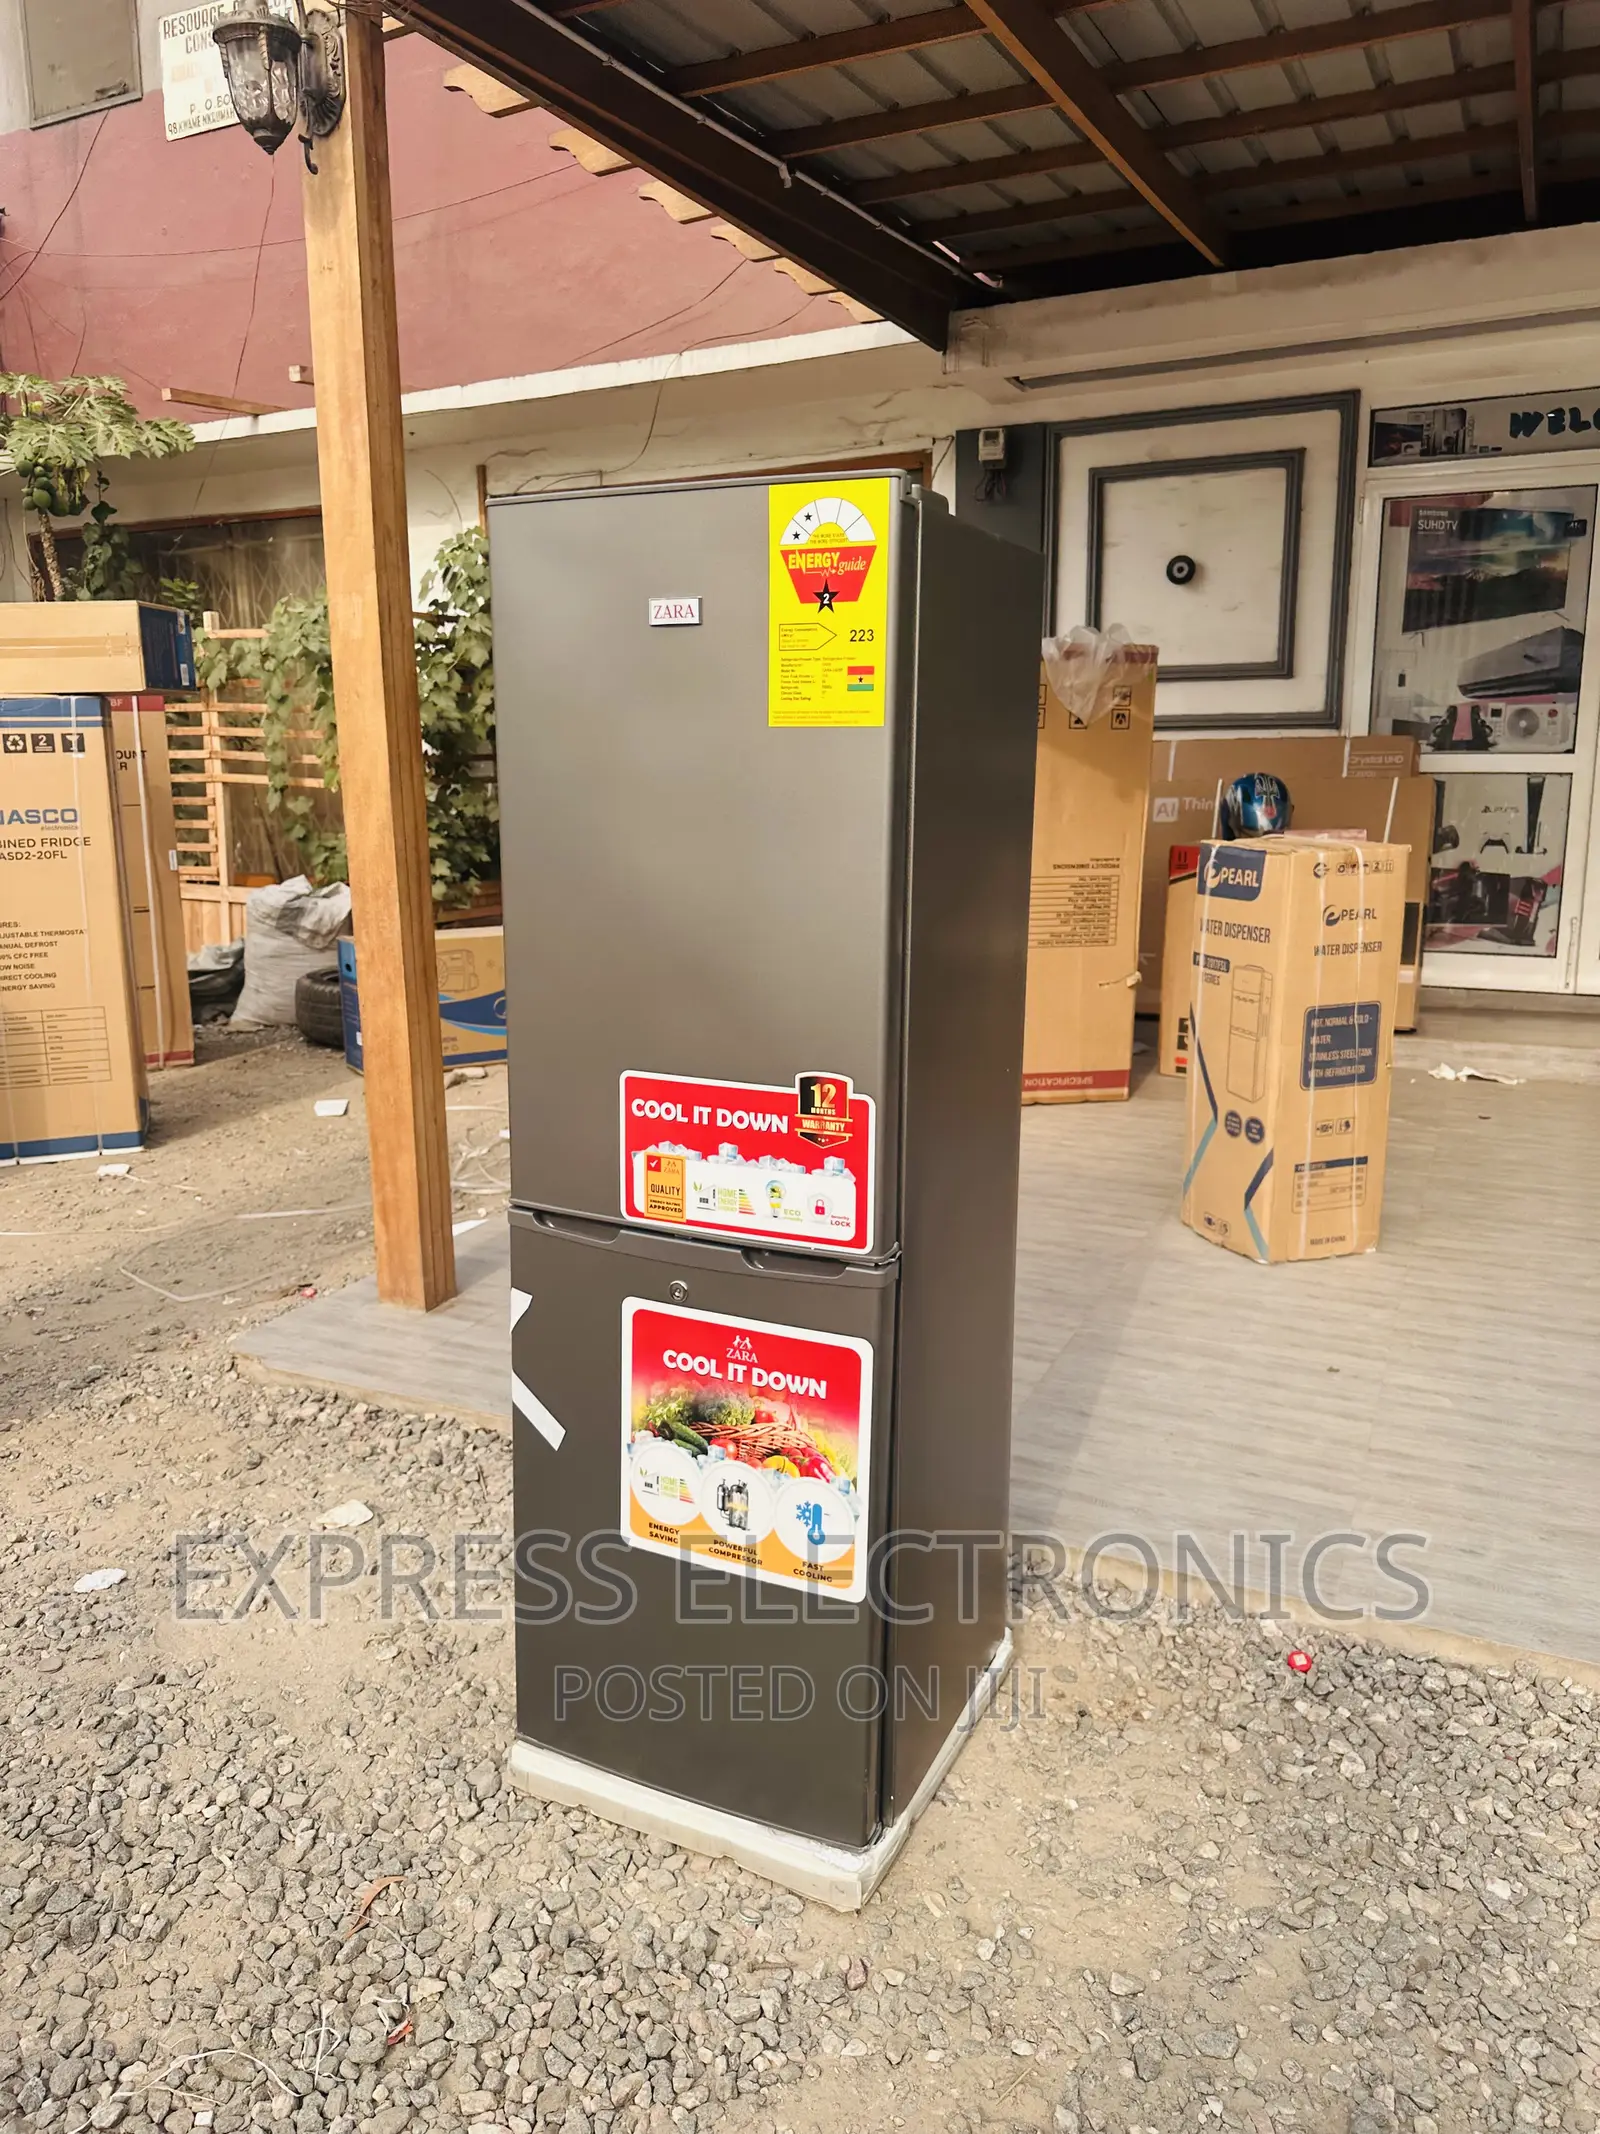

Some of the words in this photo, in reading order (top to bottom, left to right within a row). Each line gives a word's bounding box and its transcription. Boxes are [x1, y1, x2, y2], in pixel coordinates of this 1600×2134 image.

[788, 550, 840, 574] ENERGY
[838, 556, 866, 575] guide
[823, 593, 830, 605] 2
[654, 604, 695, 620] ZARA
[849, 629, 875, 642] 223
[0, 808, 78, 825] ASCO
[0, 837, 36, 848] INED
[1224, 921, 1271, 944] DISPENSER
[24, 972, 57, 980] COOLING
[29, 982, 56, 990] SAVING
[811, 1083, 836, 1109] 12
[631, 1098, 689, 1123] COOL
[693, 1106, 712, 1126] IT
[716, 1109, 789, 1134] DOWN
[810, 1106, 836, 1116] MONTHS
[801, 1119, 846, 1132] WARRANTY
[650, 1183, 681, 1196] QUALITY
[649, 1203, 683, 1214] APPROVED
[783, 1208, 801, 1217] ECO
[830, 1220, 851, 1228] LOCK
[726, 1347, 758, 1363] ZARA
[662, 1349, 722, 1379] COOL
[728, 1363, 747, 1383] IT
[752, 1370, 827, 1399] DOWN
[648, 1522, 680, 1535] ENERGY
[649, 1531, 679, 1544] SAVING
[713, 1540, 758, 1556] POWERFUL
[708, 1547, 763, 1566] COMPRESSOR
[802, 1562, 824, 1573] FAST
[793, 1568, 833, 1583] COOLING
